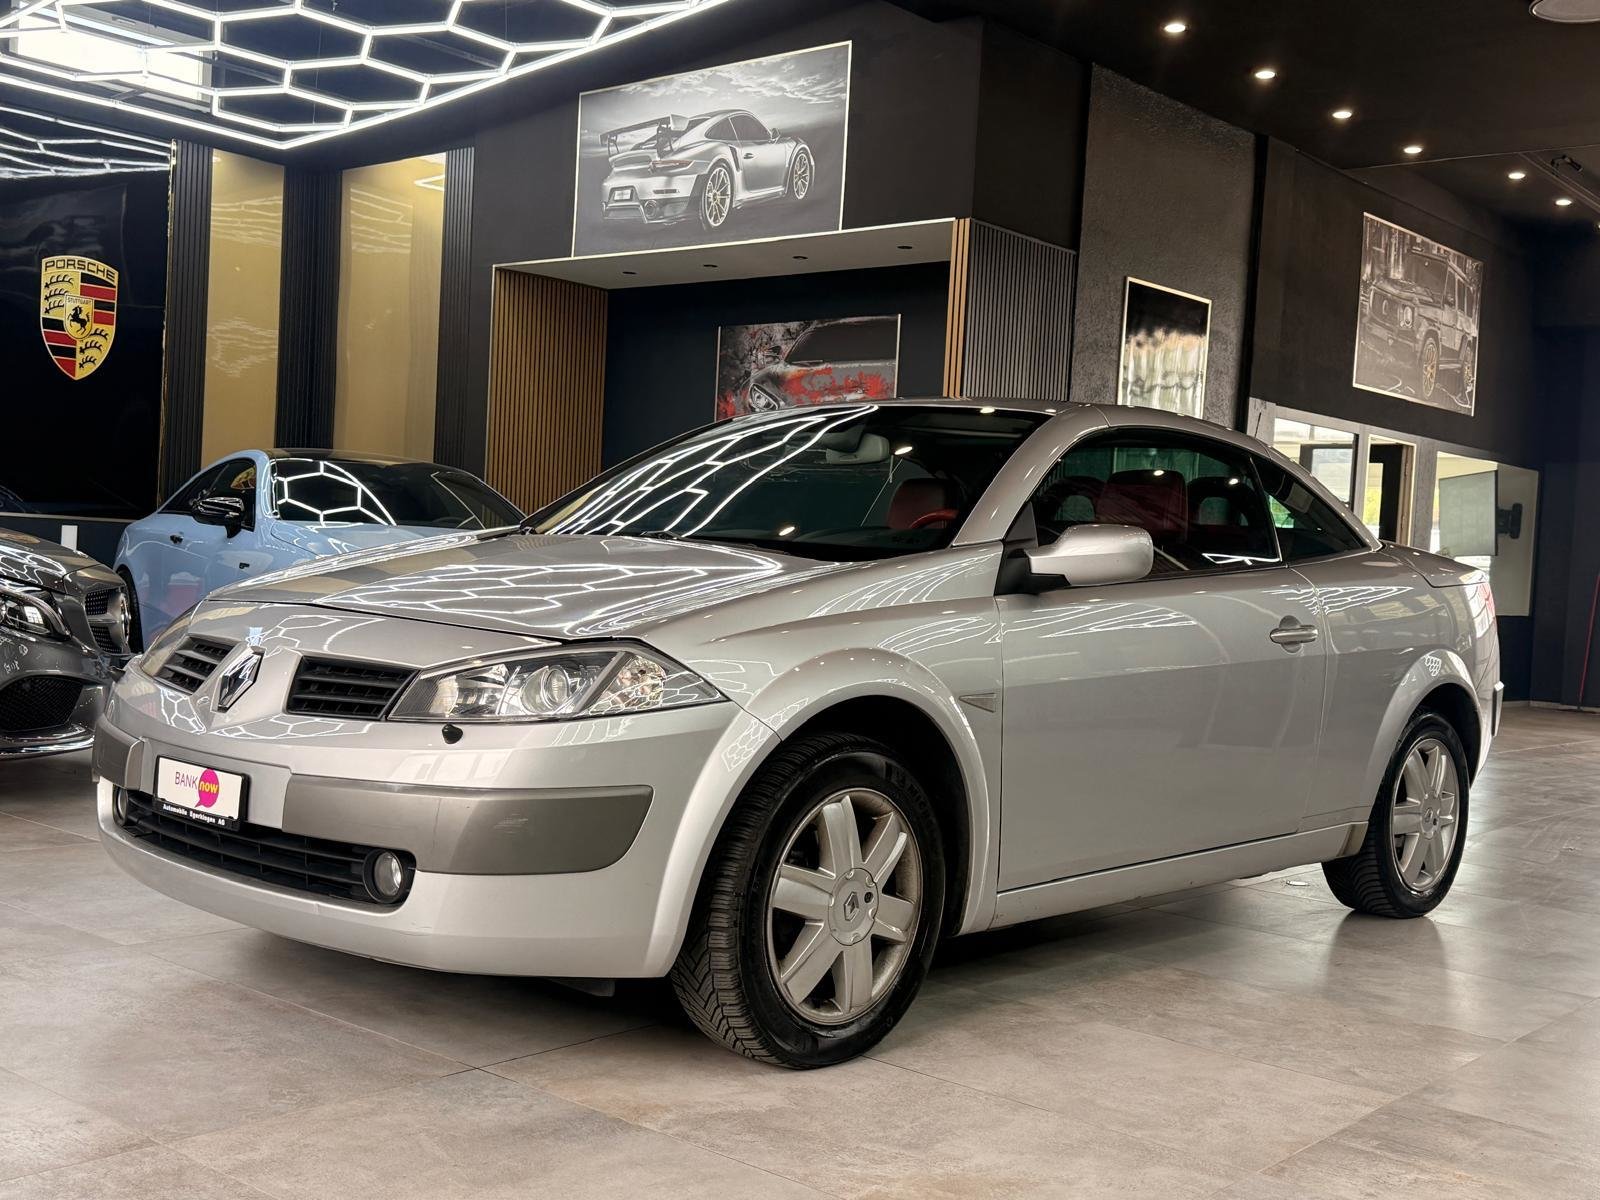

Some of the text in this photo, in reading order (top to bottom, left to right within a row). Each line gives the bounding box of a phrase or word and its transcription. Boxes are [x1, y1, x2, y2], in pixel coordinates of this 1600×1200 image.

[45, 259, 116, 282] PORSCHE
[175, 771, 219, 794] BANK now
[163, 803, 187, 815] Automobile
